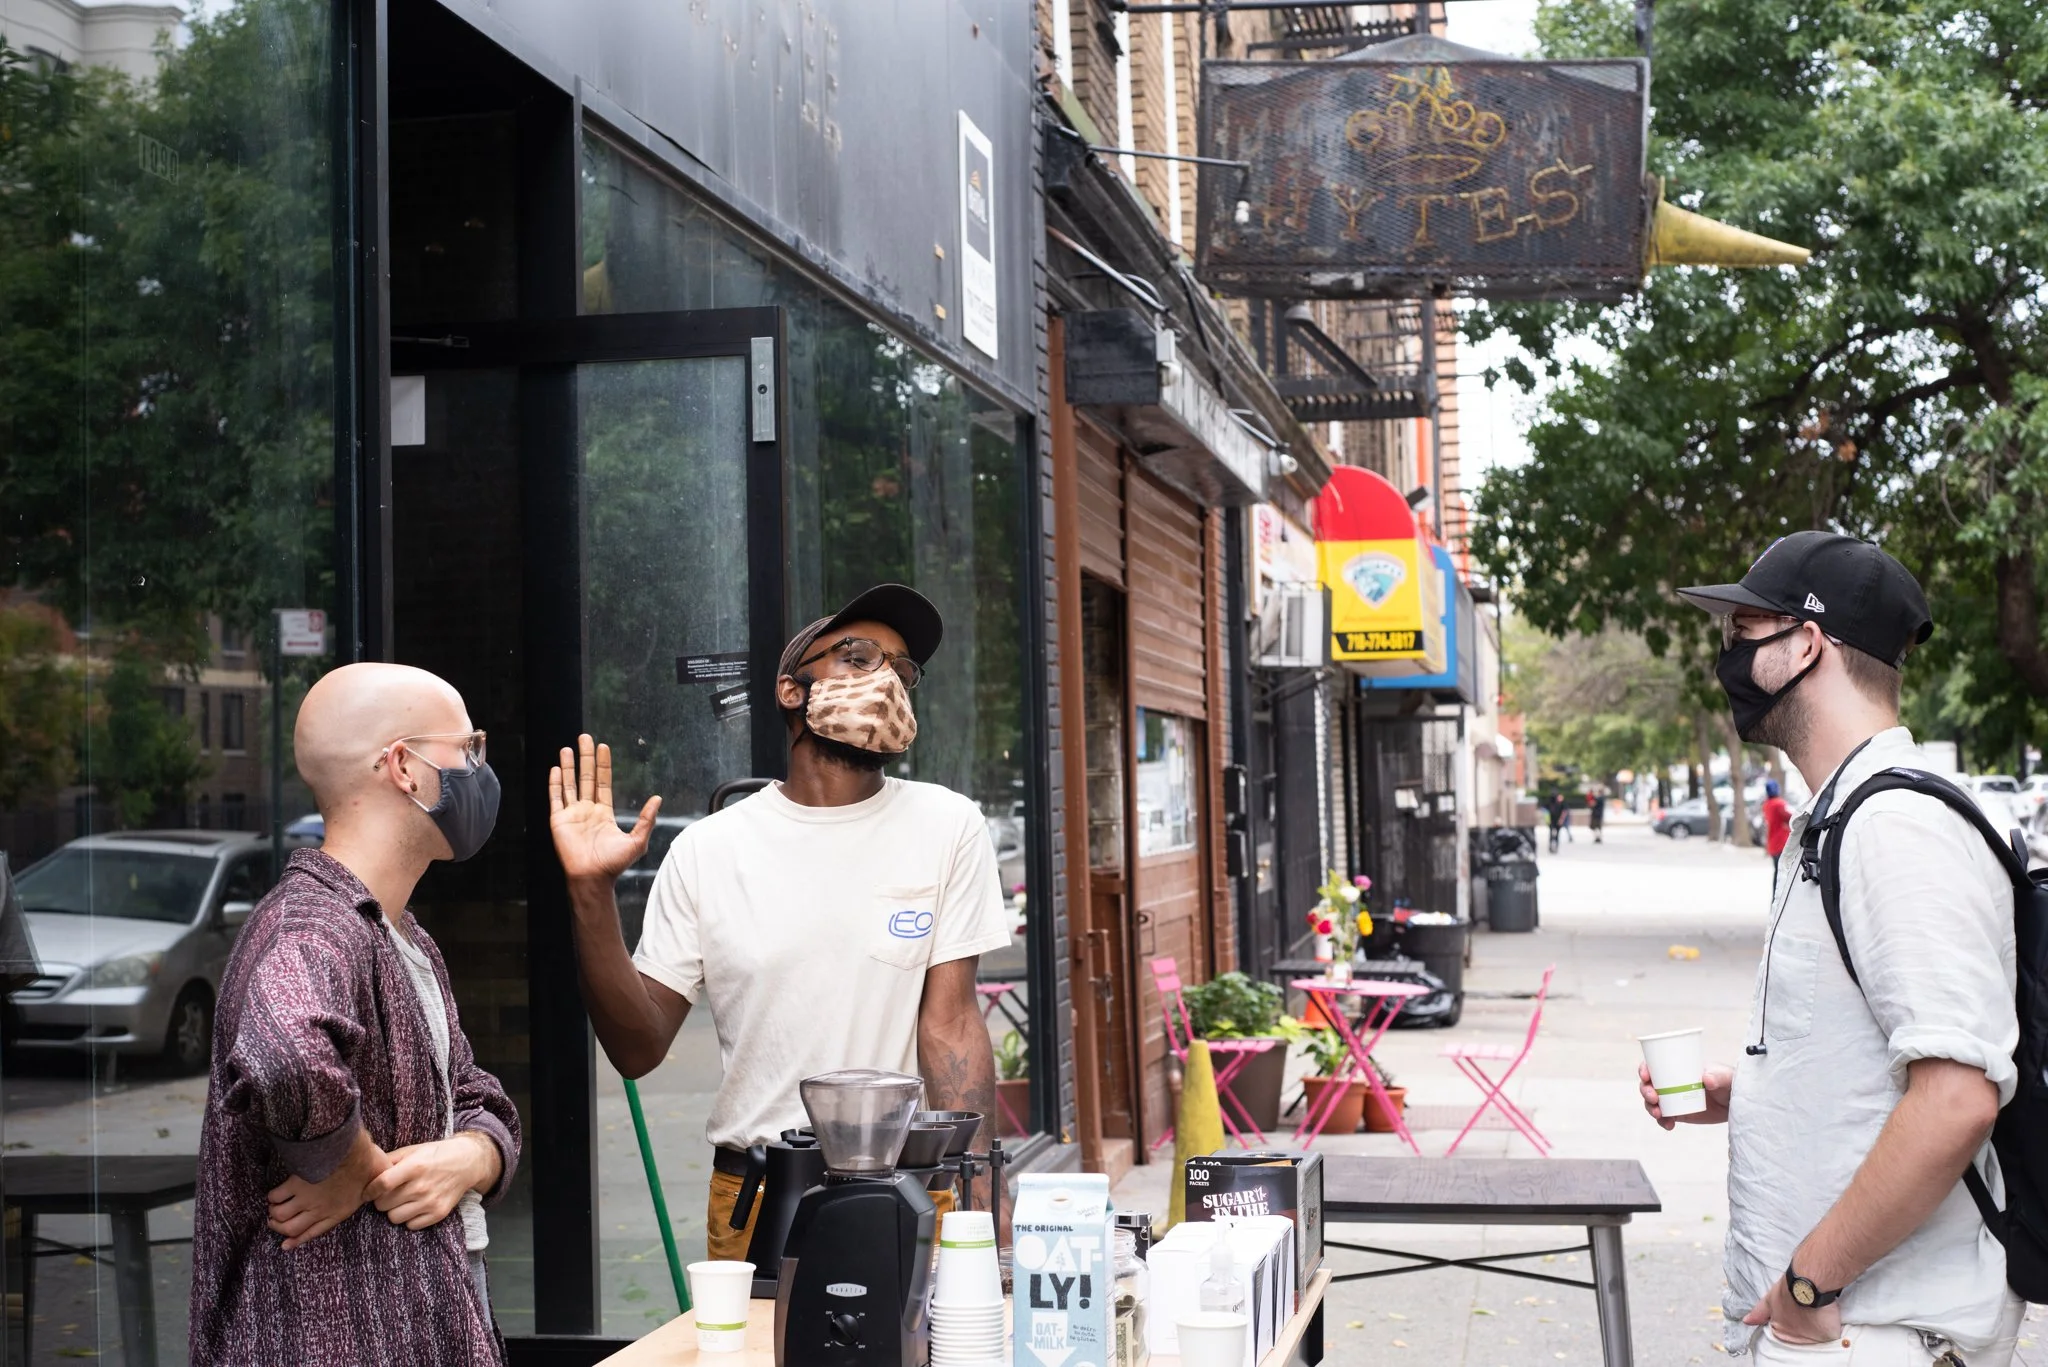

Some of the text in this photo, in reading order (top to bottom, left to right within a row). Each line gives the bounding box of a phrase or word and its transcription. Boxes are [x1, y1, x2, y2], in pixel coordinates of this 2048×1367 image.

[1189, 1169, 1210, 1181] 100
[1202, 1190, 1257, 1209] SUGAR
[1214, 1206, 1232, 1217] IN
[1233, 1202, 1270, 1217] THE
[1014, 1224, 1074, 1233] THE ORIGINAL
[1015, 1234, 1104, 1272] OAT-
[1029, 1273, 1092, 1311] LY!
[1035, 1322, 1063, 1336] OAT-
[1033, 1336, 1065, 1350] MILK
